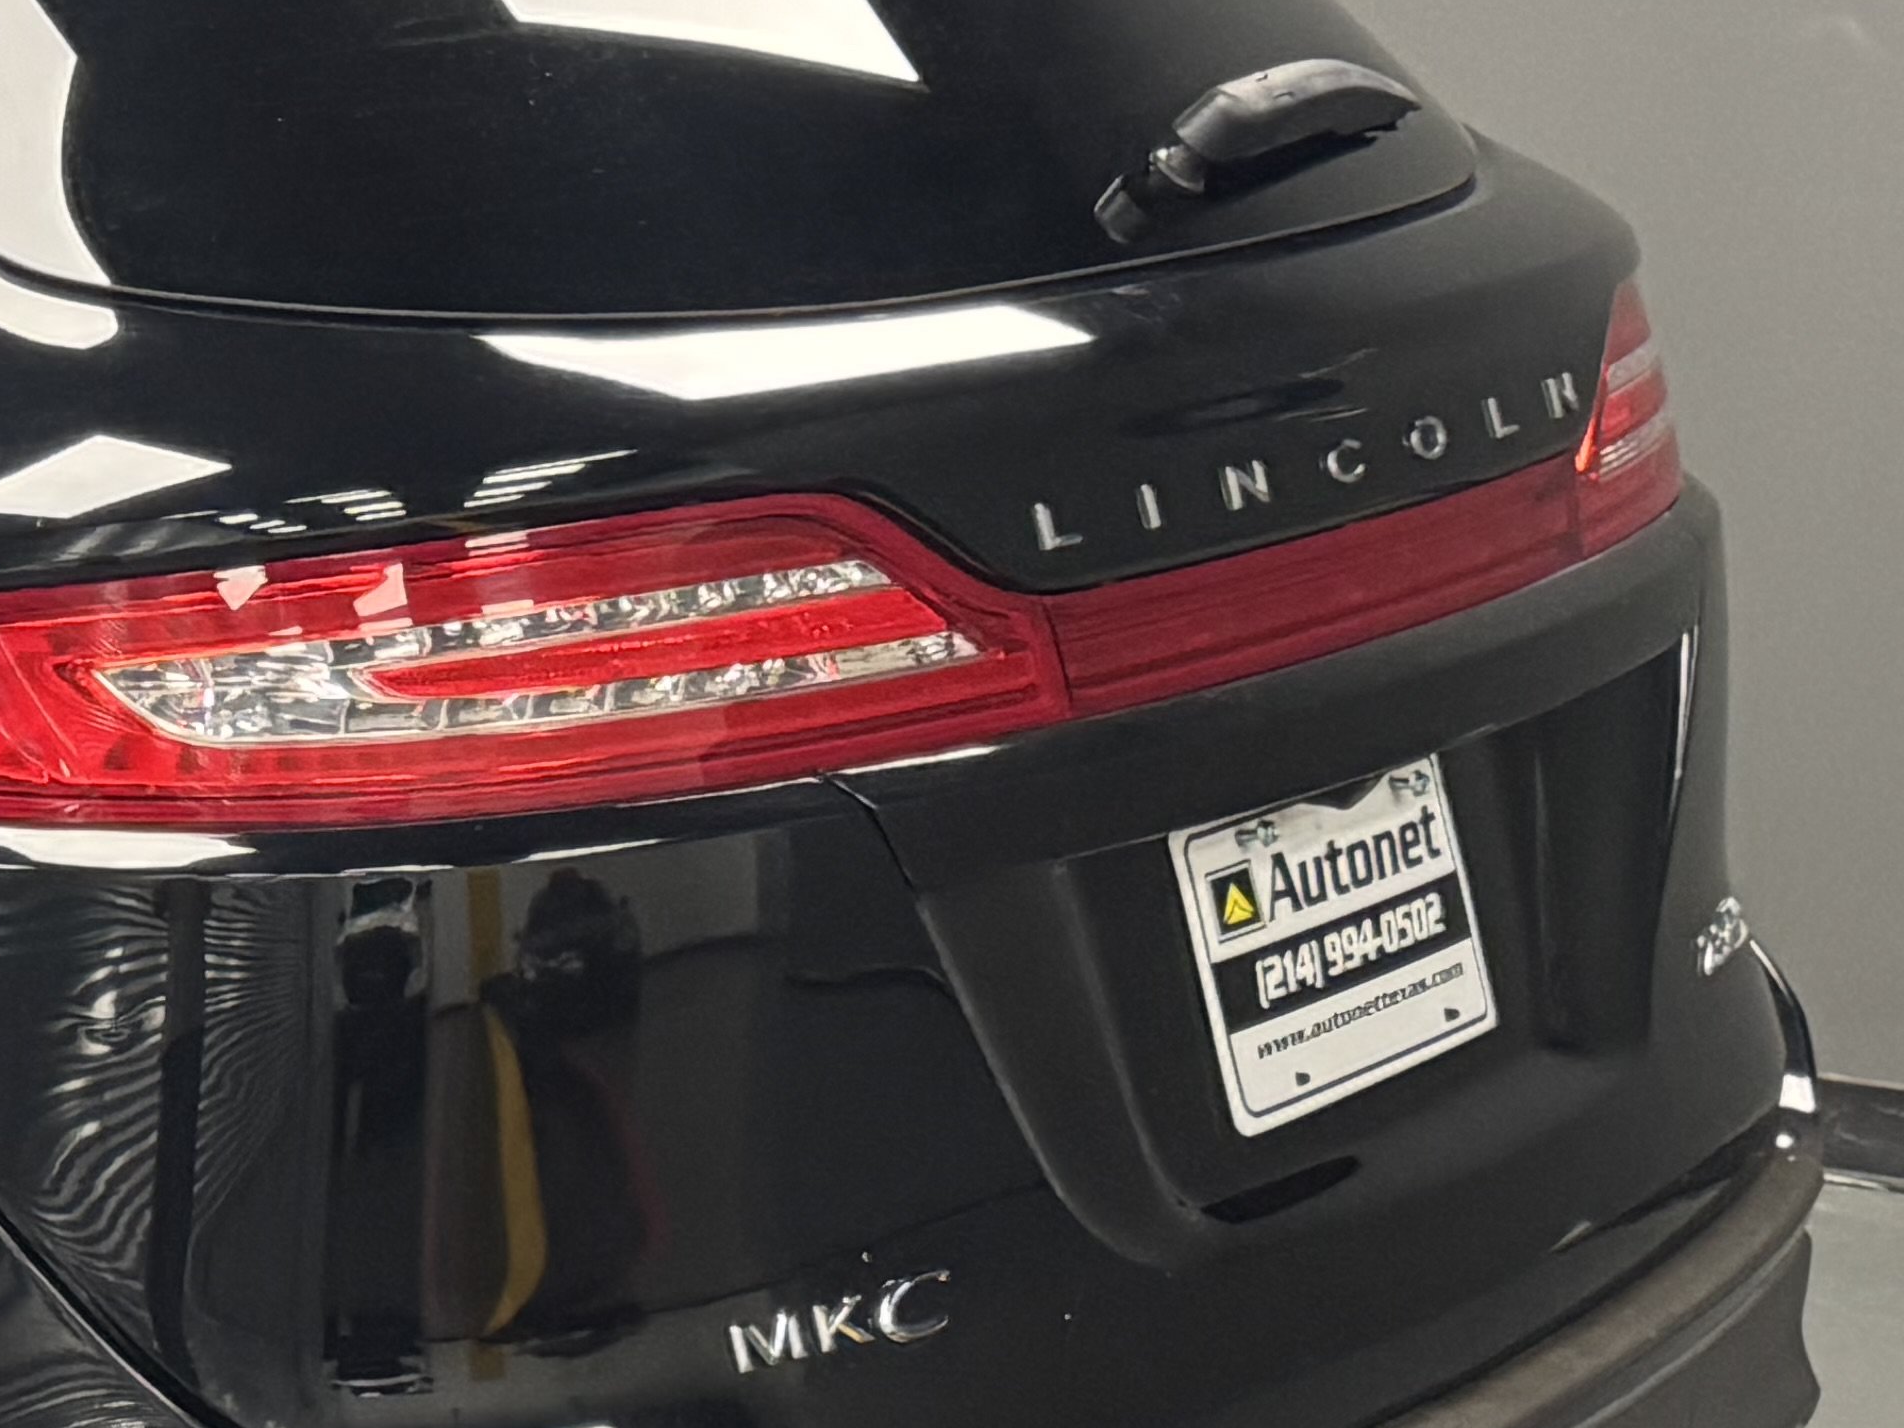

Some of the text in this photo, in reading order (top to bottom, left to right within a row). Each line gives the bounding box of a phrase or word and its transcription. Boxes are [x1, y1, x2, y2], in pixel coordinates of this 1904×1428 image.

[1031, 371, 1580, 551] LINCOLN
[1269, 804, 1441, 923] Autonet
[1254, 891, 1447, 1010] (214) 994-0502
[728, 1268, 952, 1375] MKC
